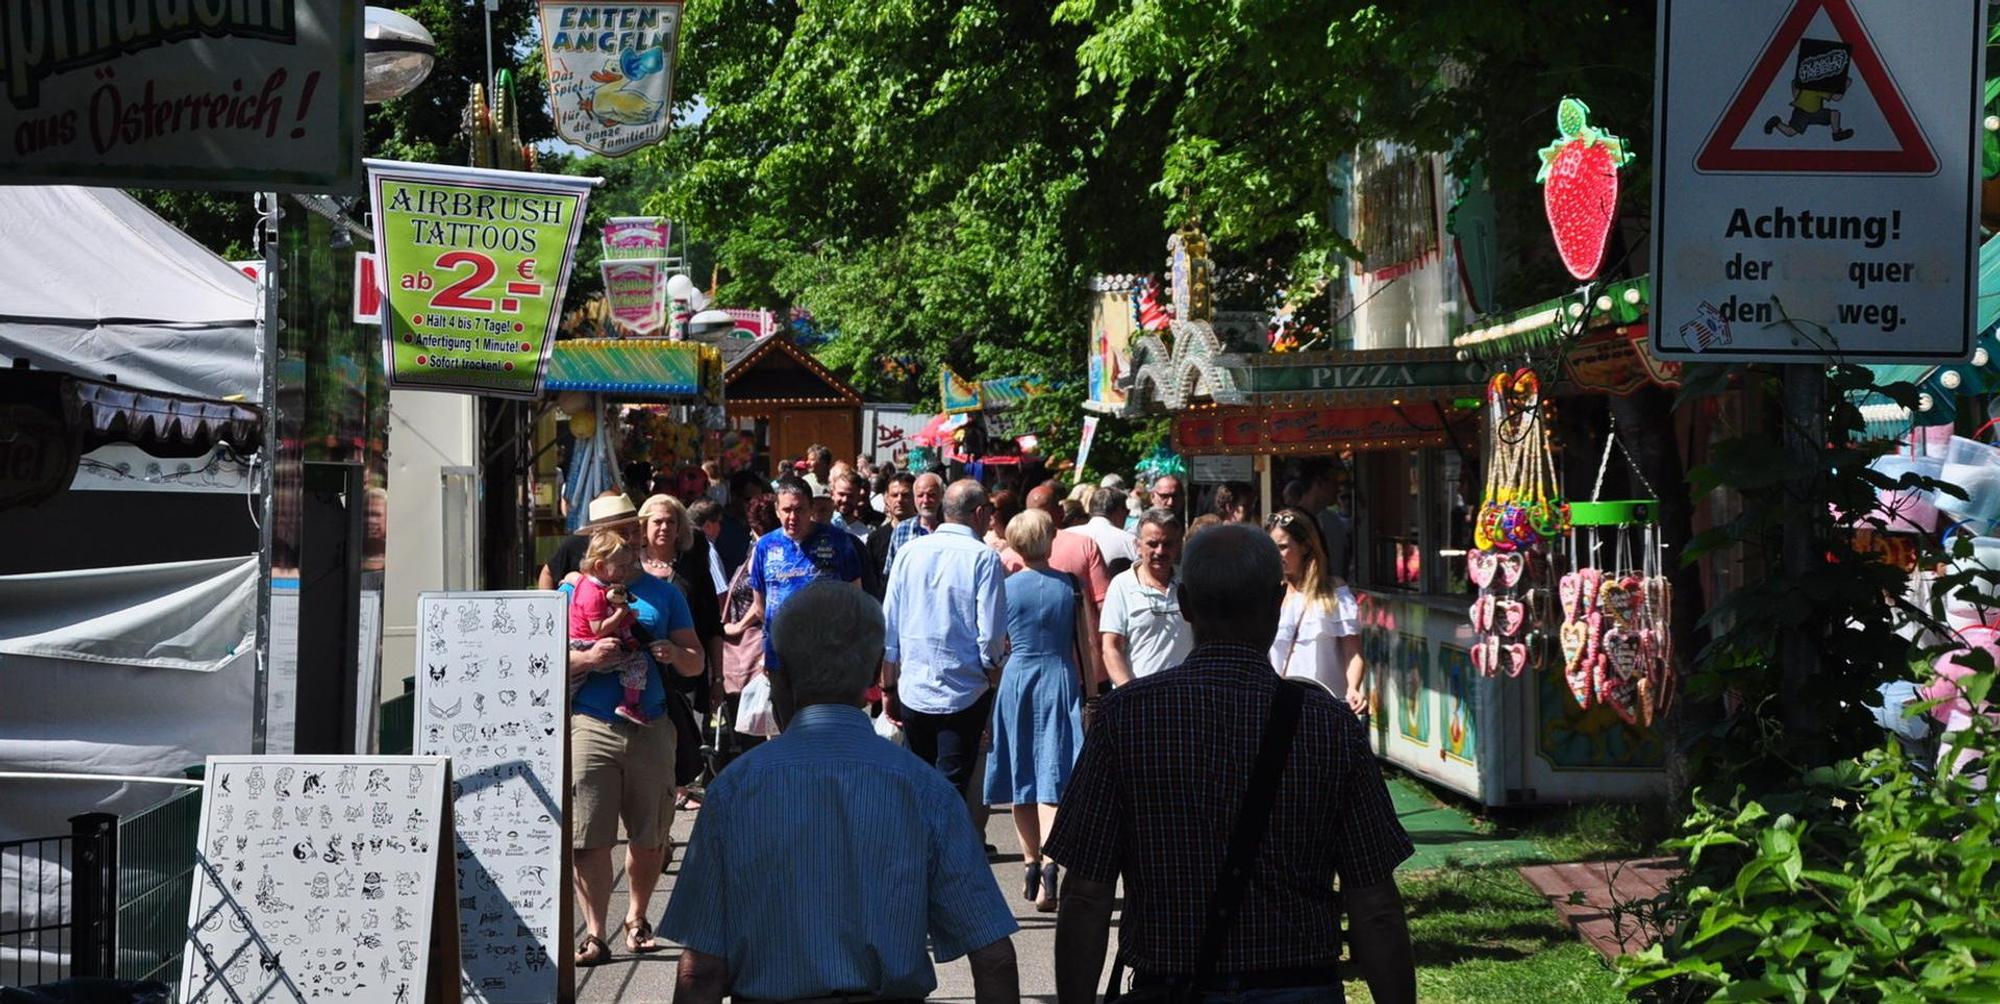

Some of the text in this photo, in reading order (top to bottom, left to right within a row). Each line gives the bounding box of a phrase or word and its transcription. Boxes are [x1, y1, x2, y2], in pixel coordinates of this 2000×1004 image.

[552, 31, 672, 53] ANGELN
[551, 70, 574, 83] Das
[562, 111, 580, 125] für
[573, 121, 590, 133] die
[15, 109, 78, 155] aus
[585, 126, 620, 142] ganze
[389, 188, 563, 224] AIRBRUSH
[411, 219, 537, 252] TATTOOS
[1725, 207, 1900, 248] Achtung!
[401, 271, 433, 290] ab
[1725, 253, 1914, 289] der quer
[1720, 295, 1906, 332] den weg.
[426, 314, 511, 334] Hält 4 bis 7 Tage!
[416, 334, 518, 353] Anfertigung 1 Minute!
[430, 354, 502, 372] Sofort trocken!
[1312, 365, 1415, 388] PIZZA
[877, 424, 904, 441] Die
[523, 897, 534, 908] Asi
